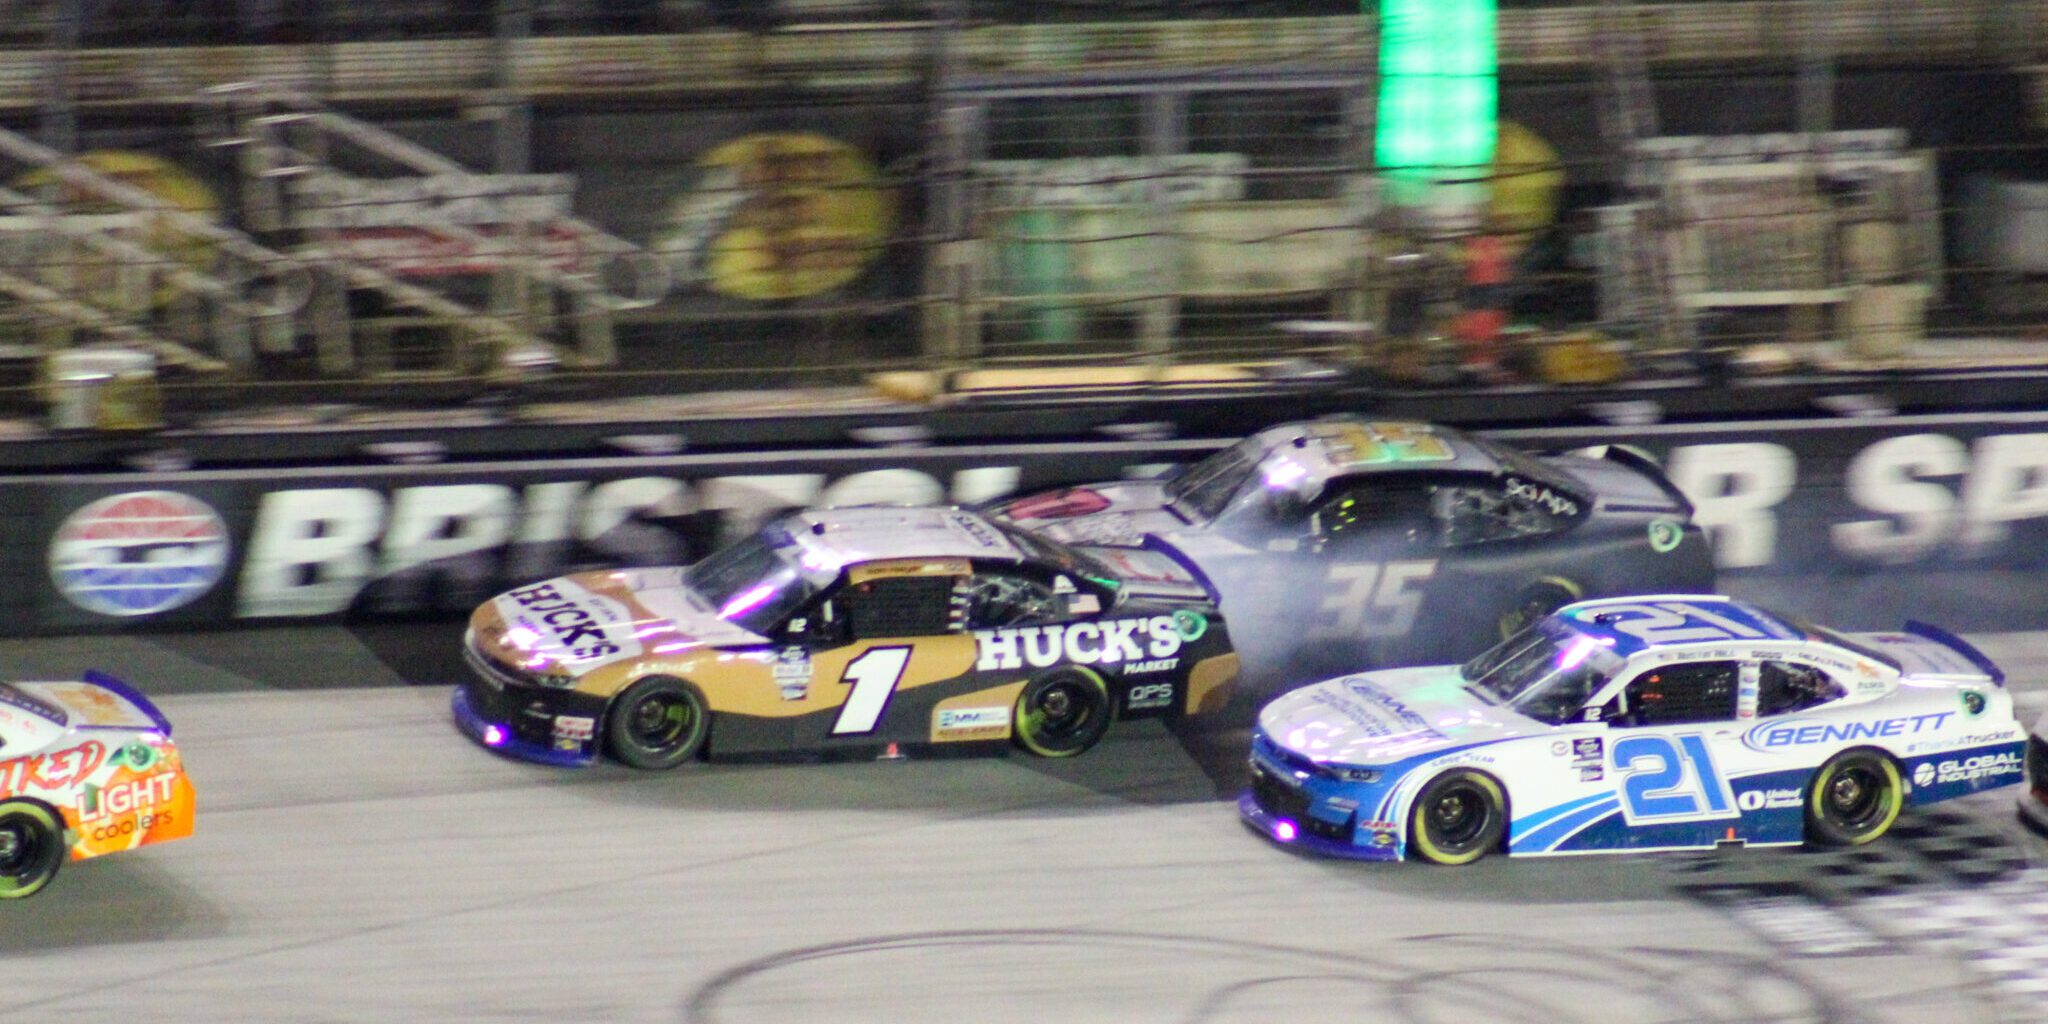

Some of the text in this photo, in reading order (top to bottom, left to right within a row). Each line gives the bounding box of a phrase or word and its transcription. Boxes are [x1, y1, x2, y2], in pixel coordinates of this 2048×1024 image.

[1304, 420, 1456, 464] 35
[236, 465, 1023, 618] BRIST
[1303, 558, 1438, 640] 35
[1576, 601, 1768, 641] 21
[975, 615, 1182, 671] HUCK'S
[1123, 658, 1180, 675] MARKET
[832, 645, 915, 735] 1
[1764, 711, 1956, 747] BENNETT
[1612, 734, 1742, 826] 21
[1937, 751, 2023, 774] GLOBAL
[1937, 764, 2023, 784] INDUSTRIAL
[76, 772, 177, 823] LIGHT
[93, 810, 174, 841] coolers
